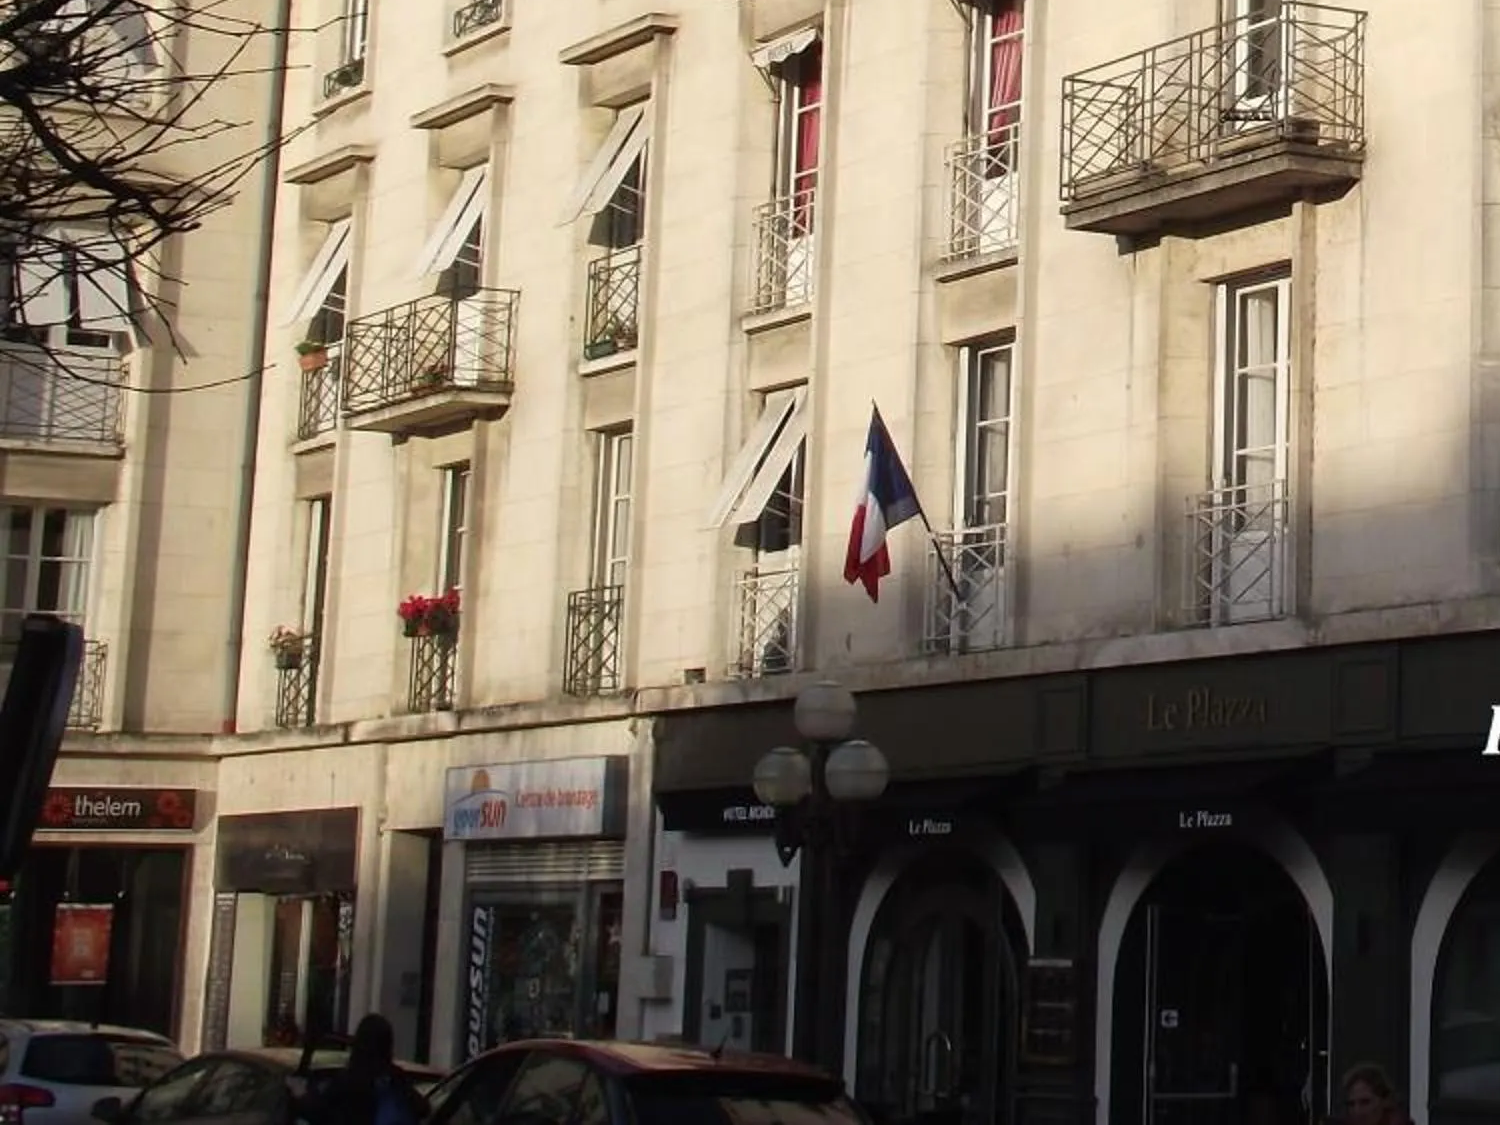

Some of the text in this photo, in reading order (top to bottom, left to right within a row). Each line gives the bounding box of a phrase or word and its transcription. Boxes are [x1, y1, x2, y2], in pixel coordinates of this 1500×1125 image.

[1146, 688, 1178, 730] Le
[74, 794, 141, 817] thelem
[1180, 811, 1195, 828] Le
